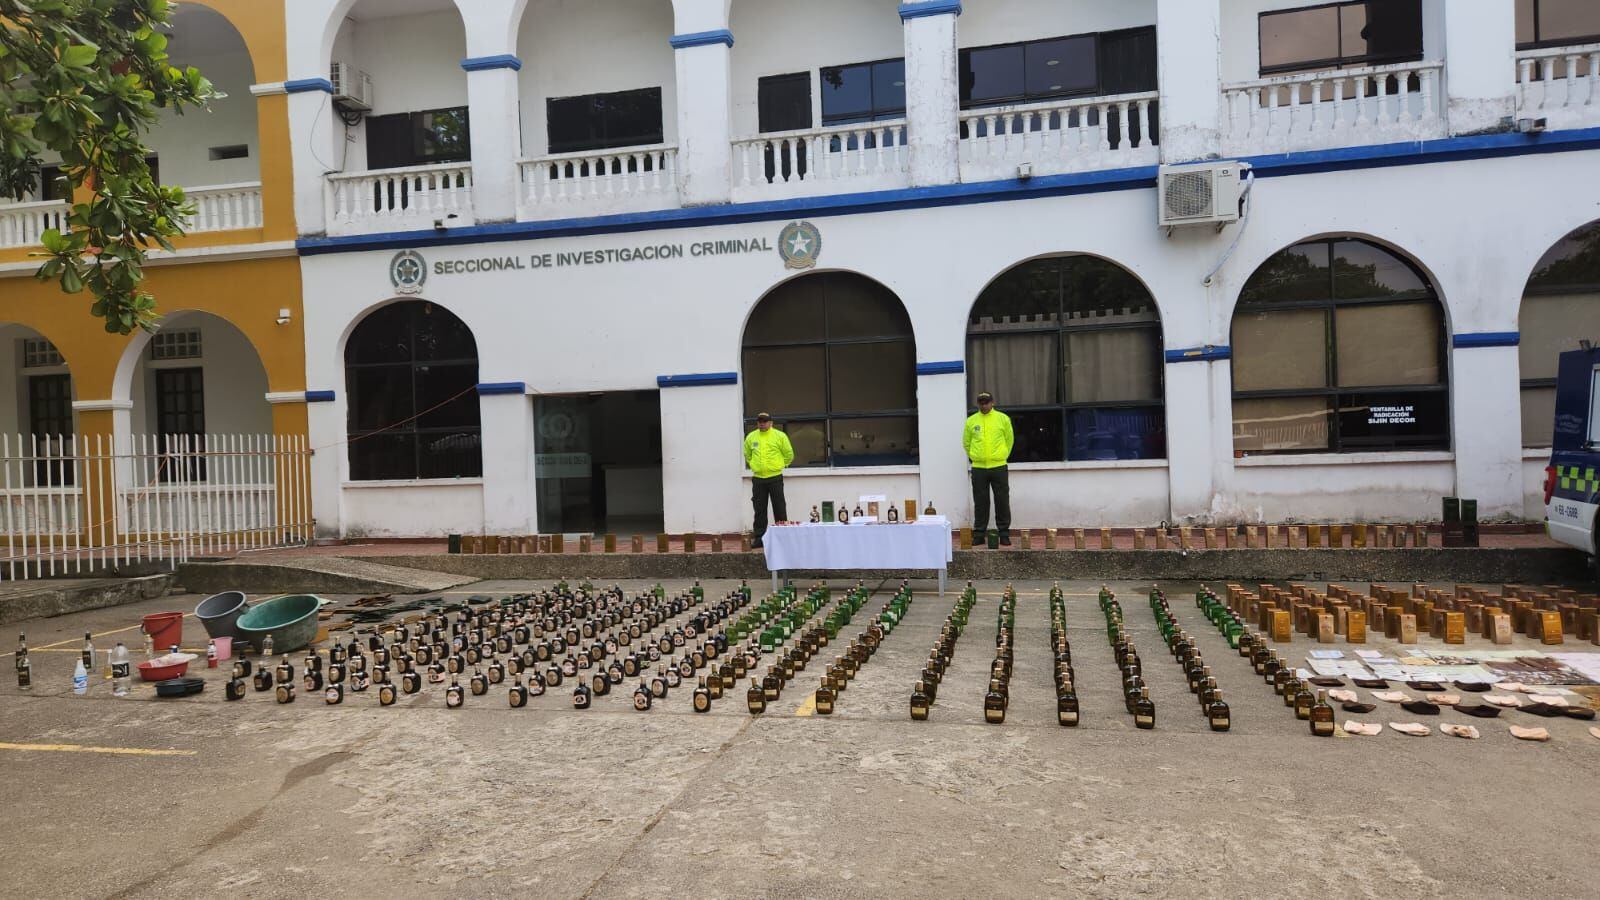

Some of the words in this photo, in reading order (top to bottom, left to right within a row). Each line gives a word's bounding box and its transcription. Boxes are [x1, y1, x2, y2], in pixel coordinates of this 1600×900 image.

[434, 256, 526, 275] SECCIONAL
[531, 253, 552, 269] DE
[690, 237, 773, 256] CRIMINAL
